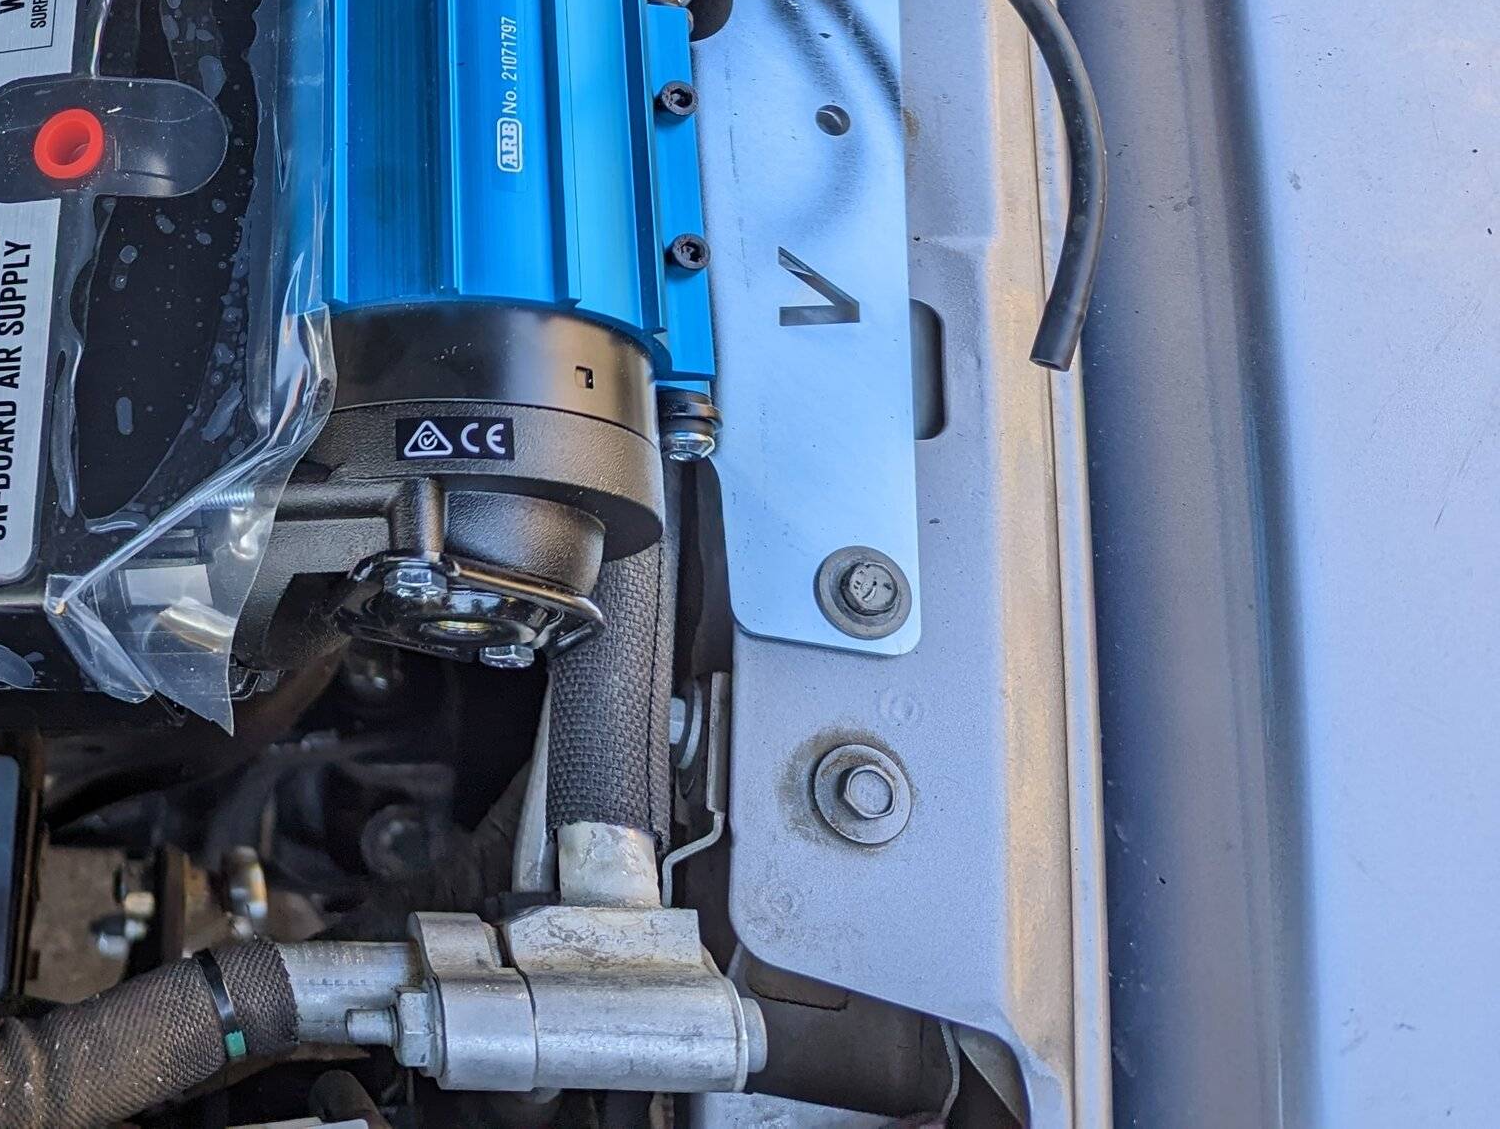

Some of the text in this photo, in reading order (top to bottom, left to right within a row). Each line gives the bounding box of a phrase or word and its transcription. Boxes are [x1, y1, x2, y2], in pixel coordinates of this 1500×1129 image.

[501, 16, 520, 168] ARB No. 21071797
[460, 422, 506, 455] CE
